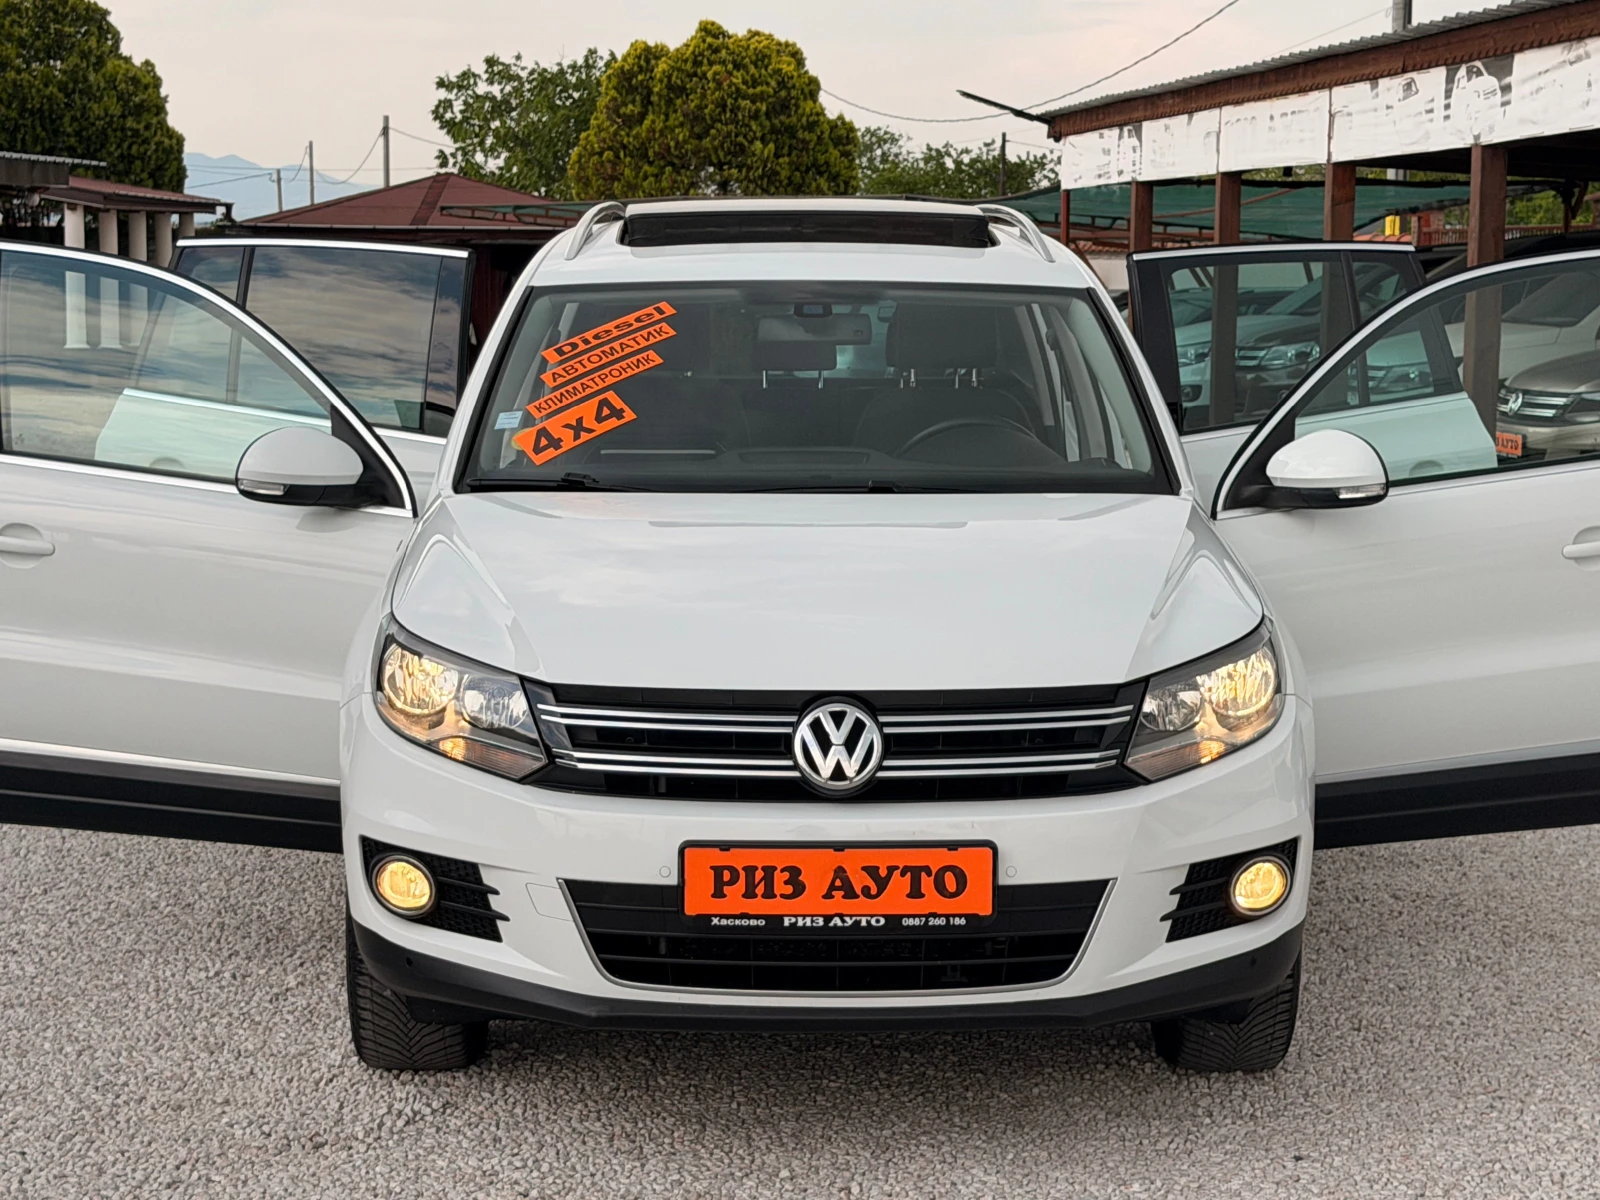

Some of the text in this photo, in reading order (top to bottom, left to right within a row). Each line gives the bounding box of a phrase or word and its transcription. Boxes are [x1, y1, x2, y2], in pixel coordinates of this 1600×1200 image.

[551, 326, 669, 383] АВТОМАТИК
[553, 306, 666, 357] Diesel
[533, 354, 656, 414] КЛИМАТРОНИК
[794, 703, 882, 790] VW
[710, 864, 968, 900] РИЗ АУТО
[711, 916, 966, 927] Хасково РИЗ АУТО 0887 260 186
